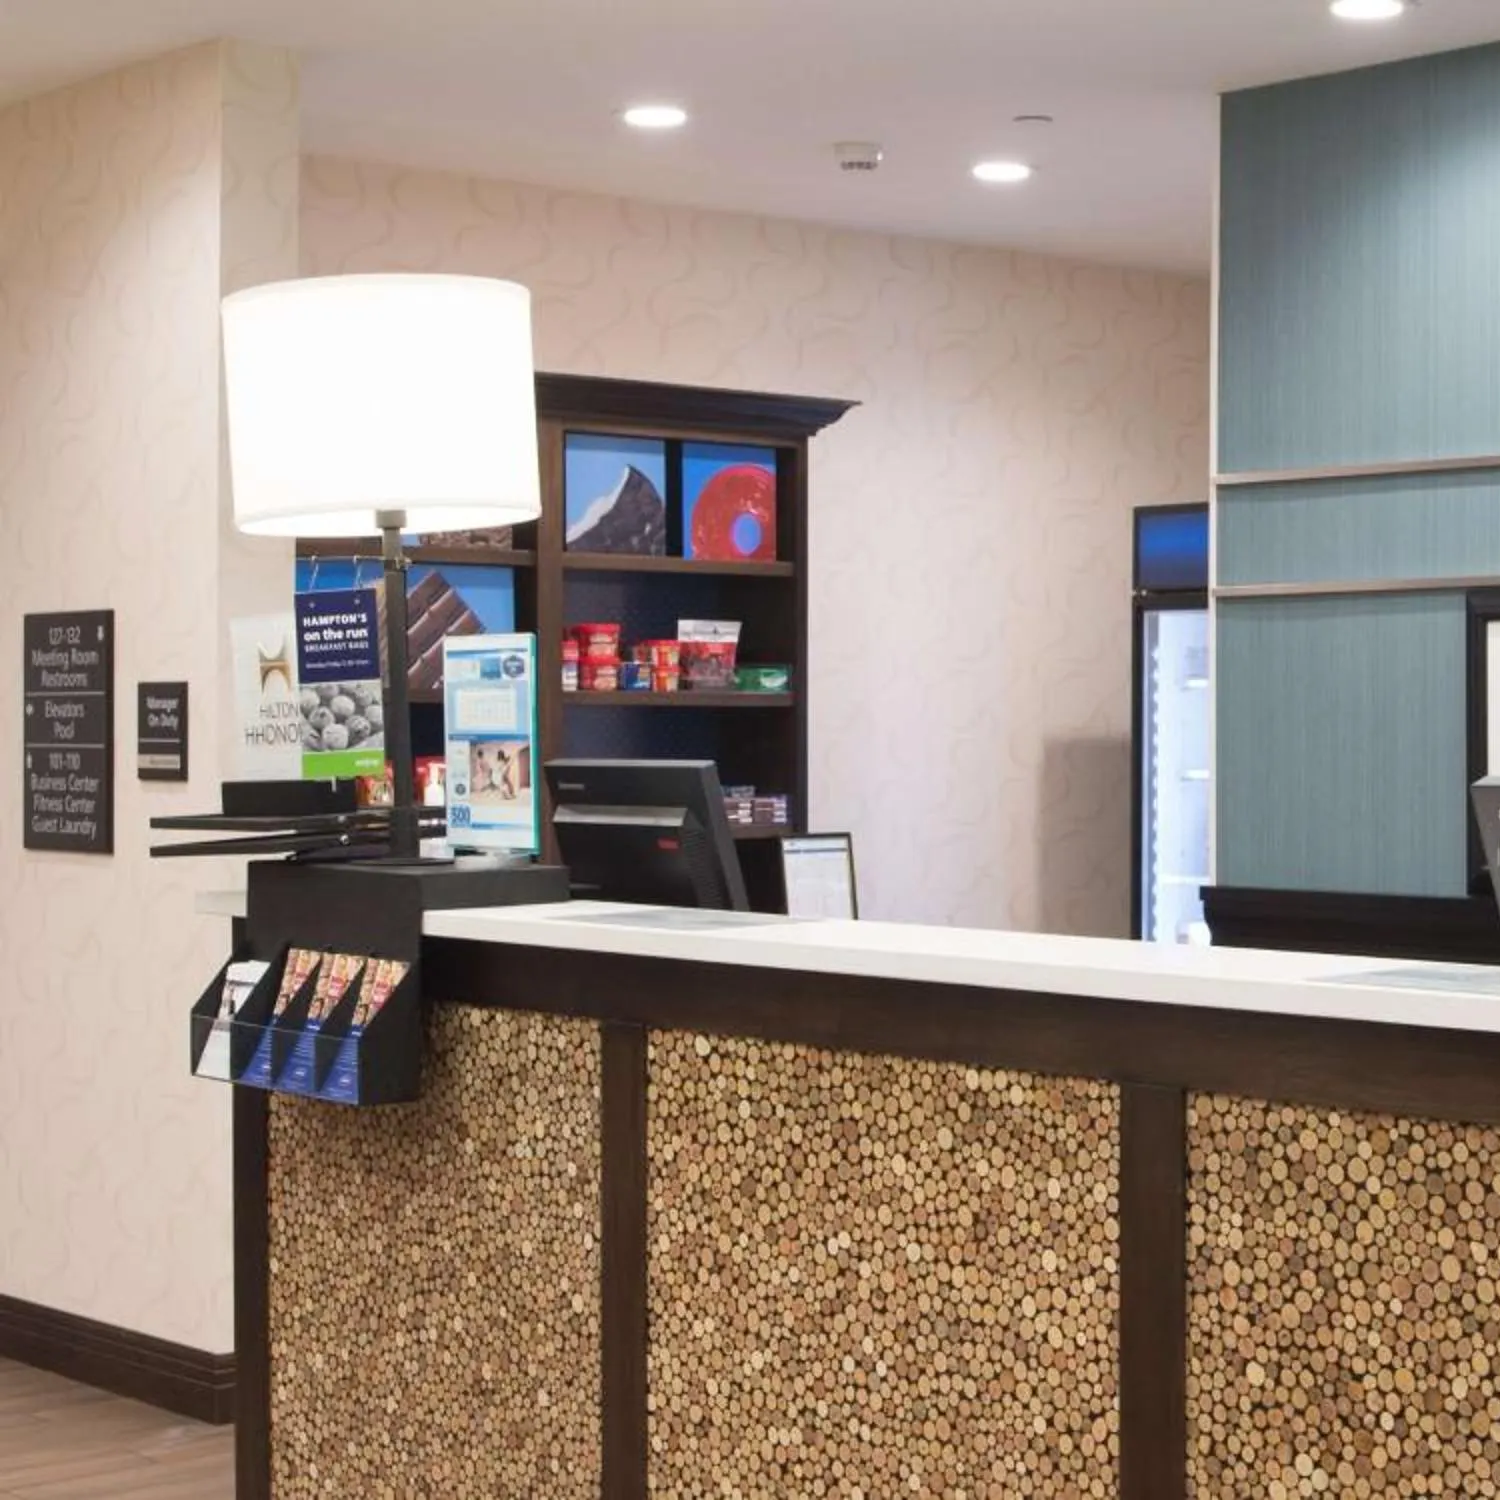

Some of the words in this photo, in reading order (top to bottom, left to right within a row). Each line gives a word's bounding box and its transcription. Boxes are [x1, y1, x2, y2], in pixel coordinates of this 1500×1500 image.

[303, 613, 367, 627] HAMPTON'S
[48, 625, 81, 645] 127-132
[303, 631, 321, 641] on
[322, 628, 344, 640] the
[345, 628, 368, 639] run
[31, 648, 69, 670] Meeting
[70, 647, 100, 665] Room
[41, 669, 89, 688] Restrooms
[44, 699, 85, 719] Elevators
[145, 696, 179, 713] Manager
[258, 702, 299, 718] HILTON
[52, 719, 76, 740] Pool
[147, 713, 159, 728] On
[160, 713, 179, 731] Duty
[31, 772, 67, 792] Business
[67, 772, 98, 792] Center
[33, 793, 64, 812] Fitness
[64, 794, 96, 813] Center
[31, 815, 58, 833] Guest
[58, 815, 97, 841] Laundry
